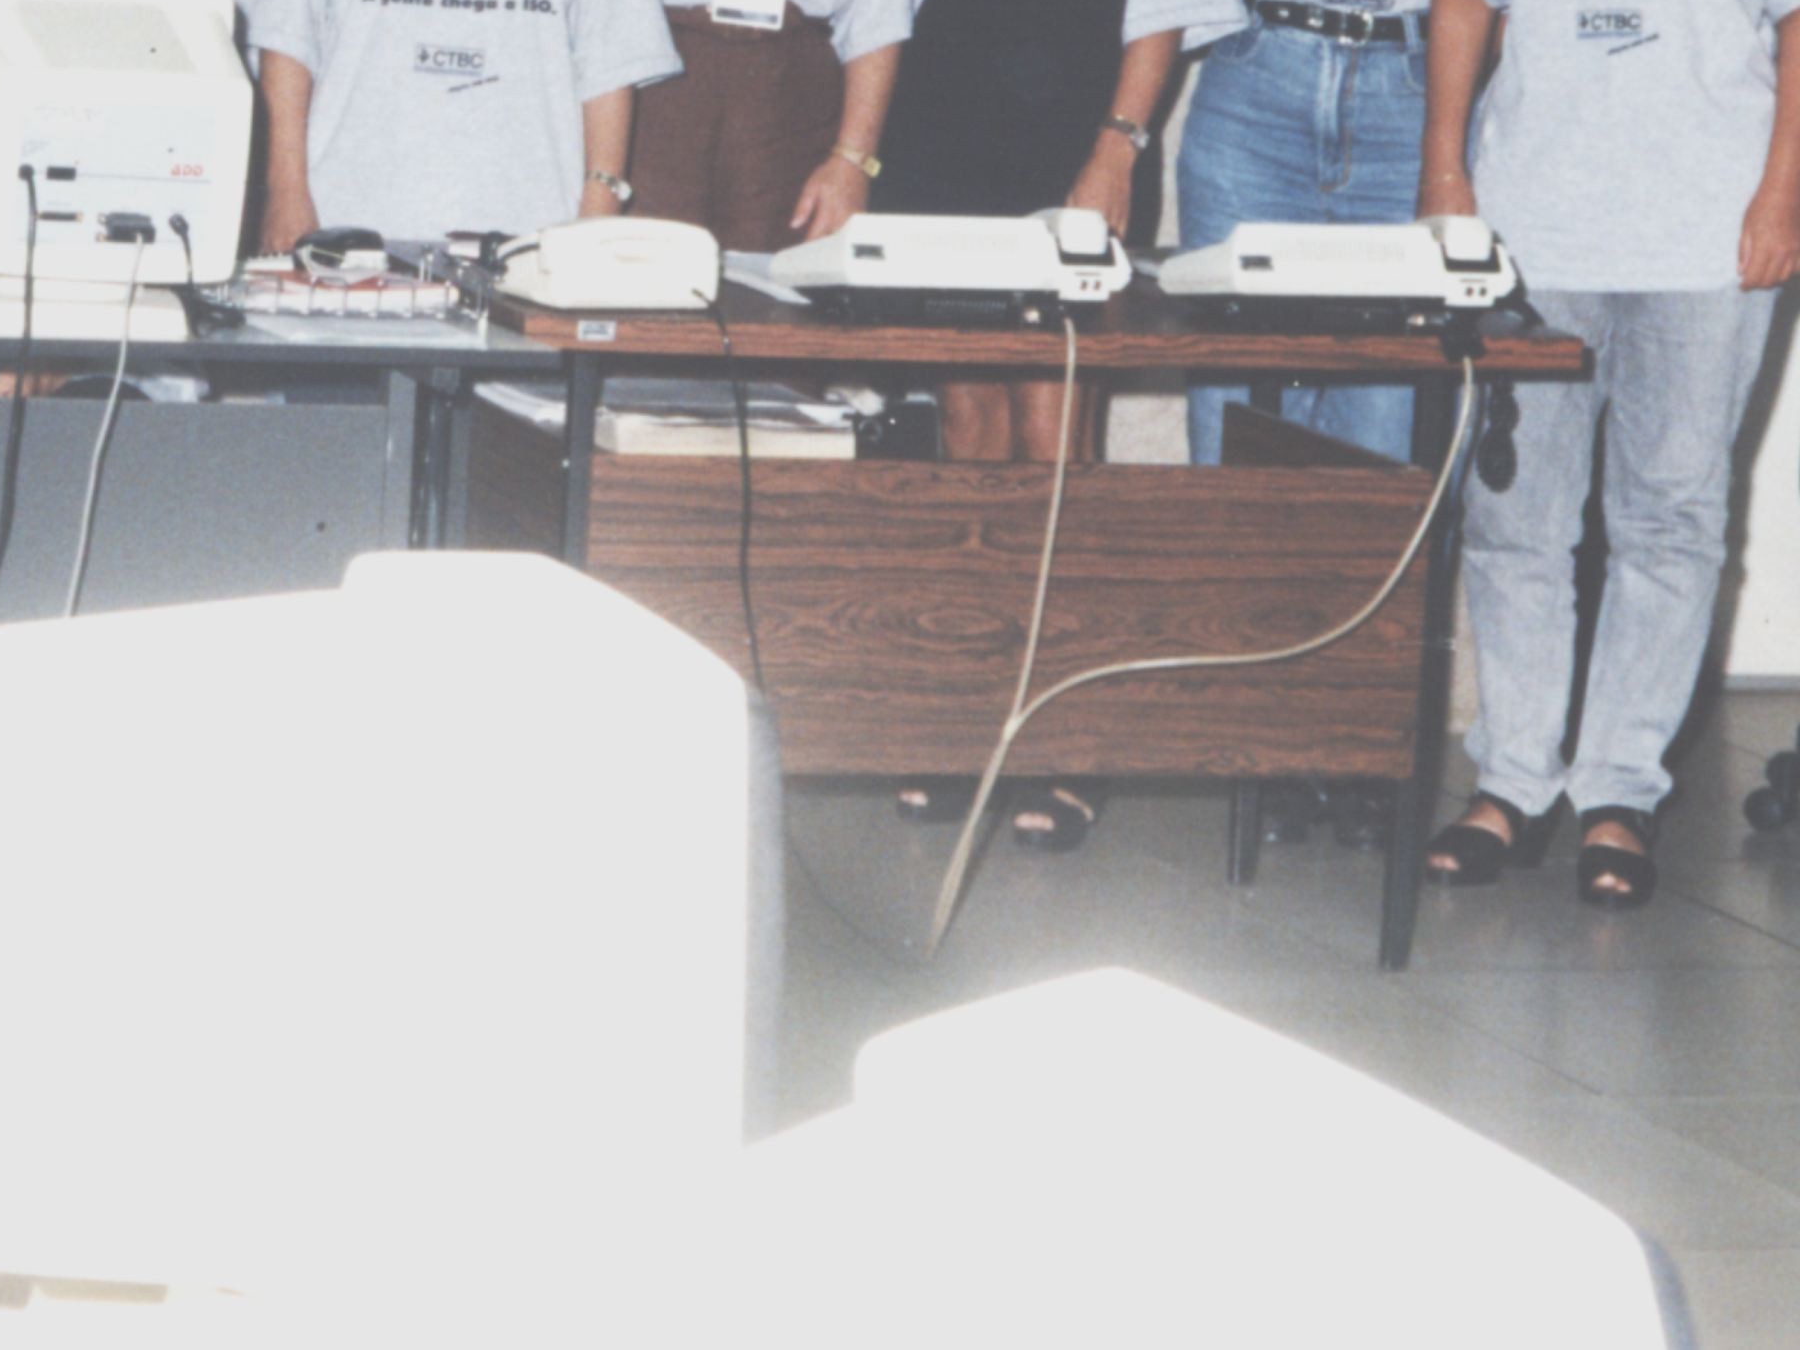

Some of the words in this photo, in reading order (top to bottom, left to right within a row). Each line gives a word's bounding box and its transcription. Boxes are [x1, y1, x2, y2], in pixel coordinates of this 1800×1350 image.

[505, 0, 516, 10] a
[1590, 14, 1641, 31] CTBC
[432, 50, 485, 70] CTBC
